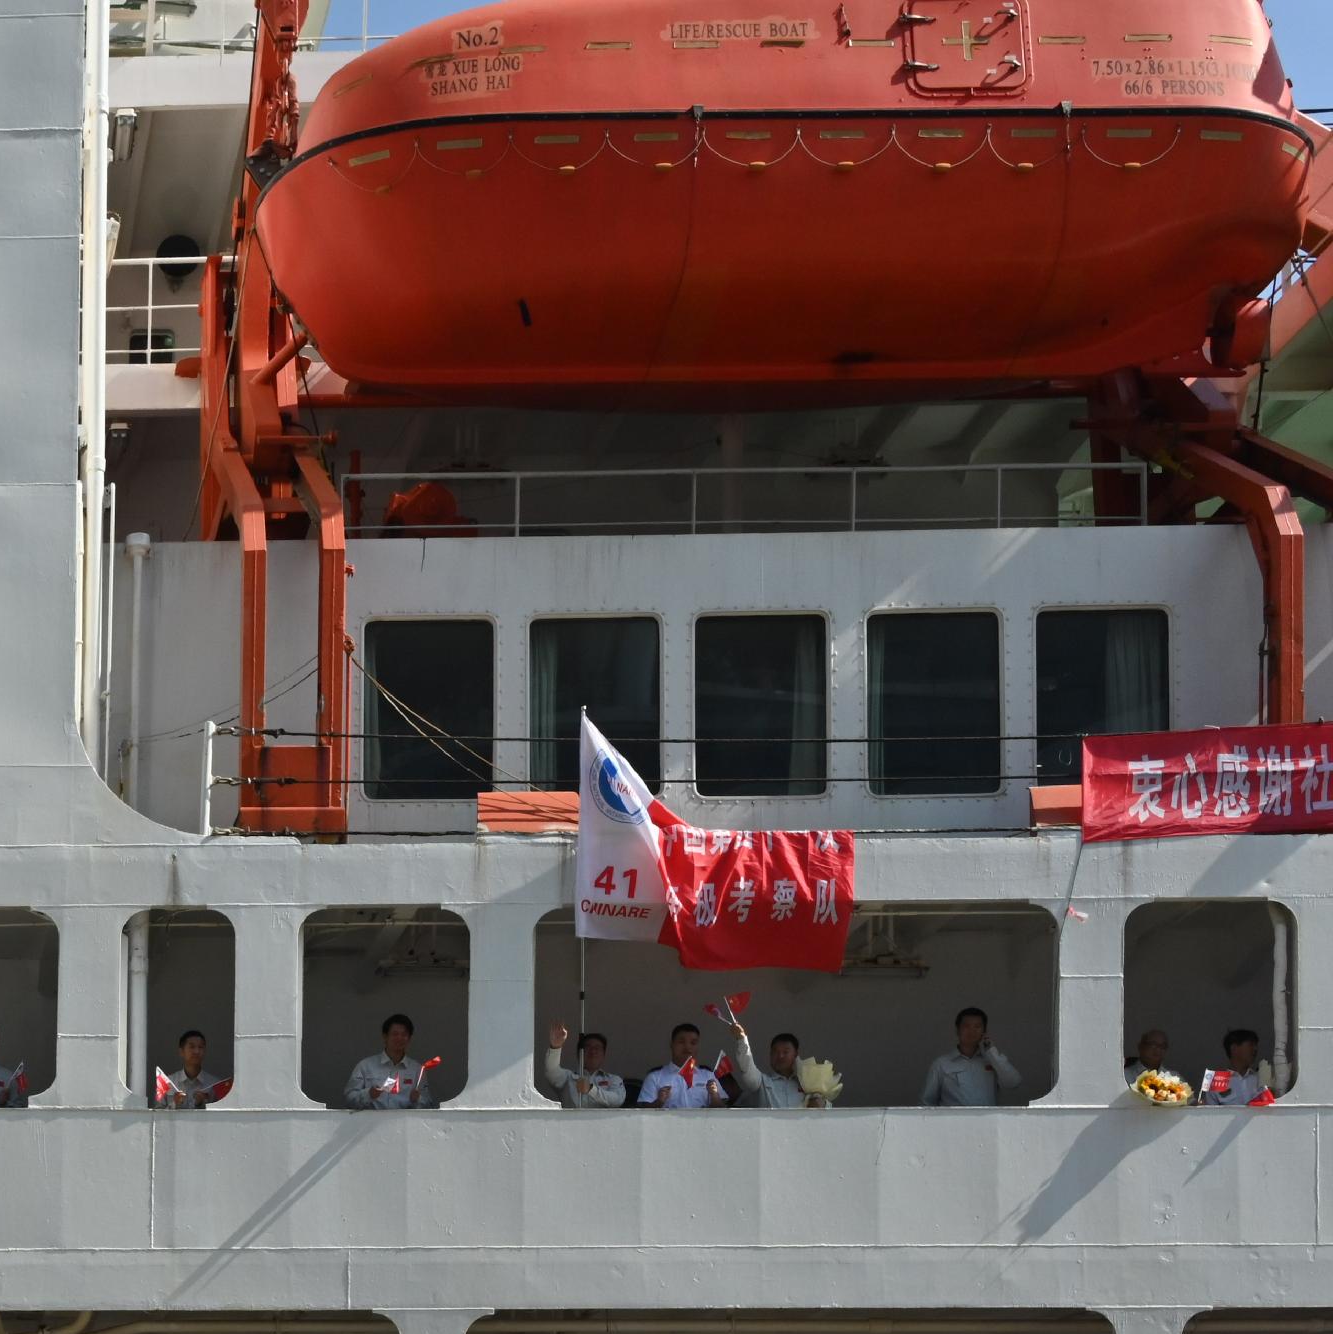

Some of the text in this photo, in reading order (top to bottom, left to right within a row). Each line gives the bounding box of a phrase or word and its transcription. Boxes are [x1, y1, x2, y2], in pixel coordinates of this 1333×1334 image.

[456, 26, 499, 49] No.2
[670, 22, 808, 39] LIFE/RESCUE BOAT
[453, 59, 479, 76] XUE
[484, 55, 521, 73] LONG
[430, 74, 511, 96] SHANG HAI
[1124, 80, 1225, 96] 66/6 PERSONS
[1128, 743, 1333, 823] 衷心感谢社
[594, 865, 638, 899] 41
